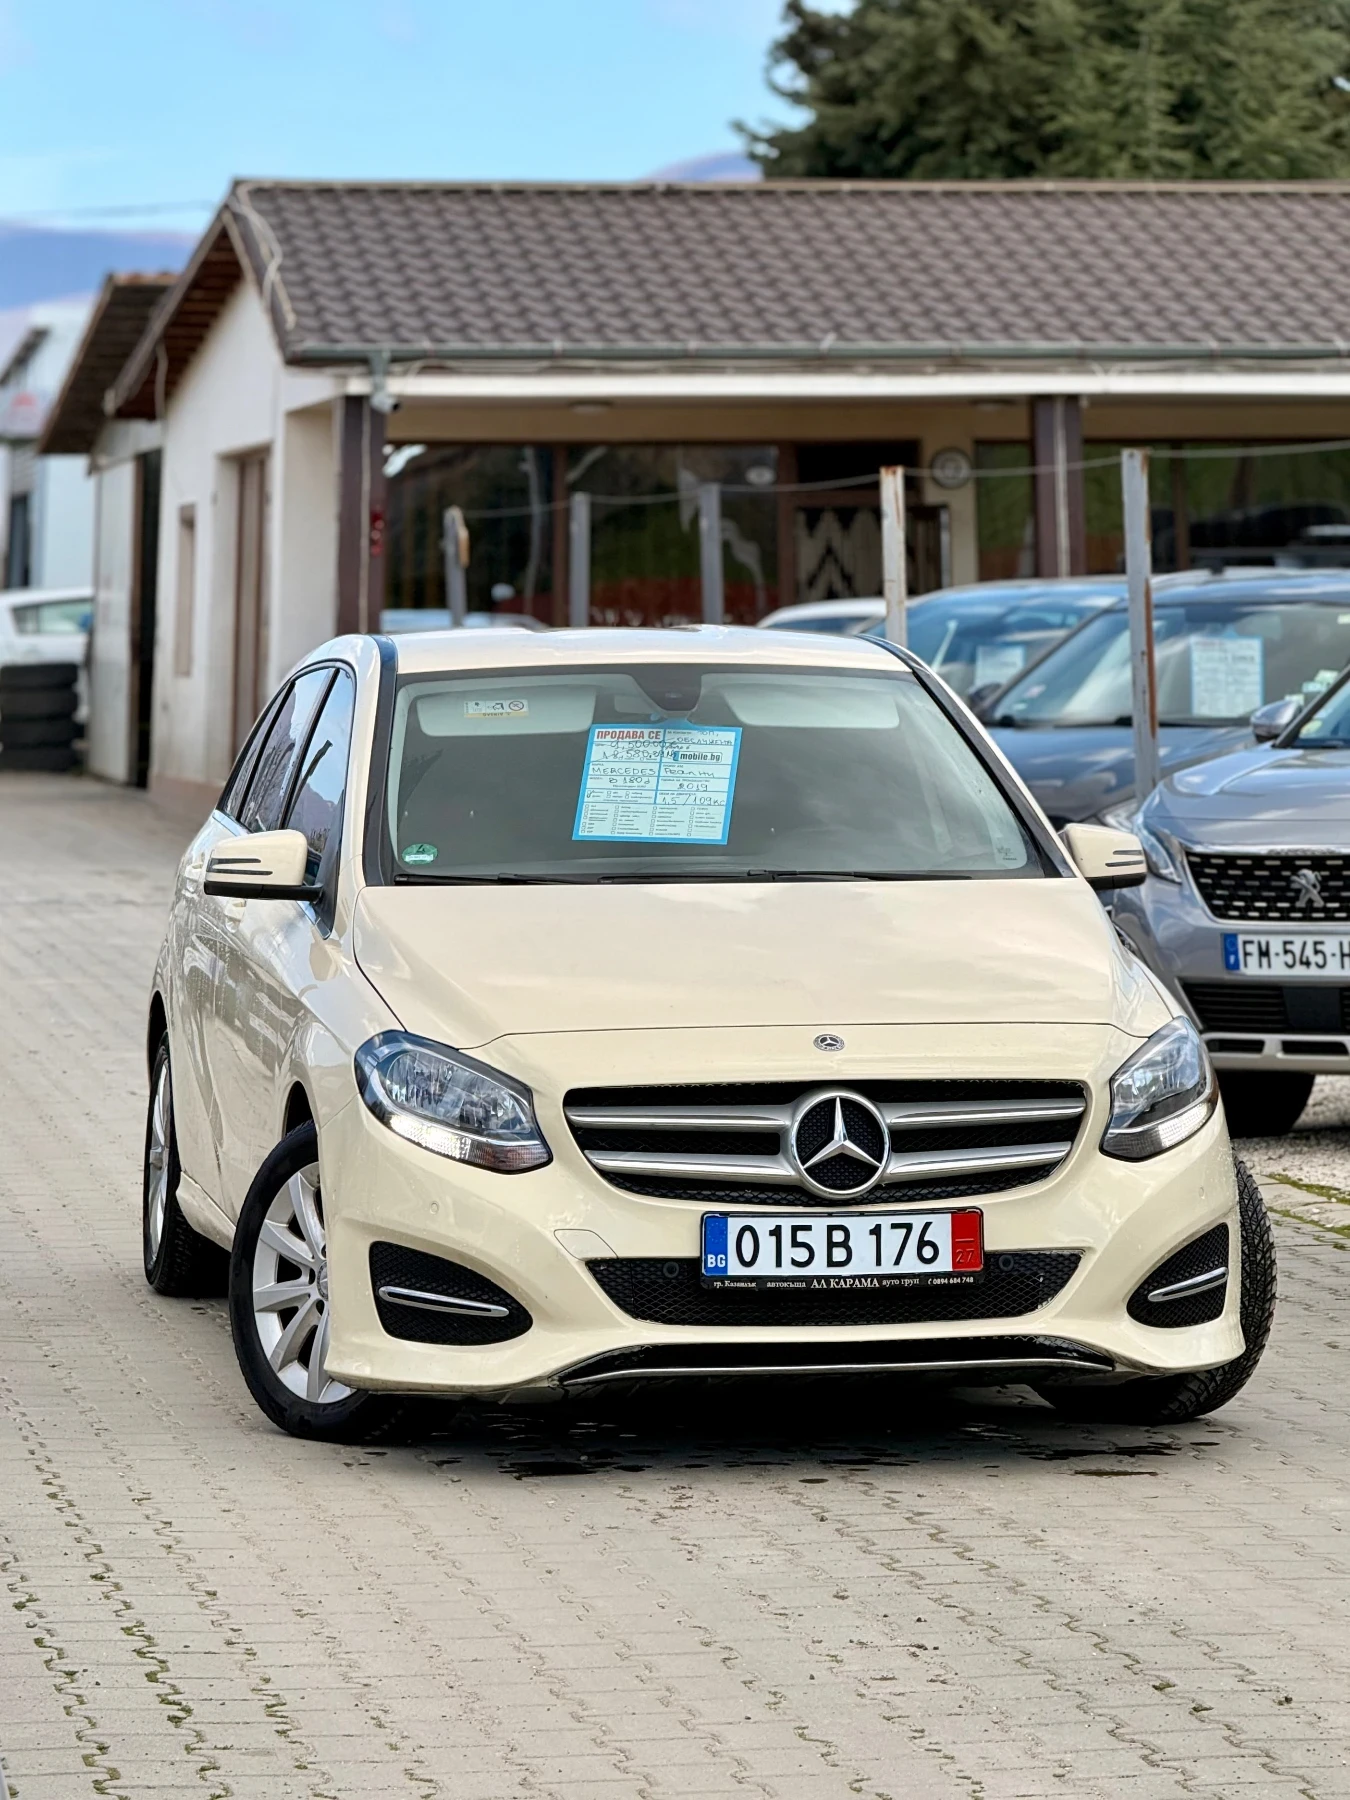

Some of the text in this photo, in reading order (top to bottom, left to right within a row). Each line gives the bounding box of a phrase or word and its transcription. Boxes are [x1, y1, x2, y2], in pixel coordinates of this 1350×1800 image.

[596, 730, 645, 740] ПРОДАВА
[647, 730, 662, 740] СЕ
[680, 753, 721, 761] mobile.bg
[592, 767, 656, 776] MERCEDES
[677, 782, 708, 791] 2019
[868, 1221, 940, 1267] 176
[955, 1248, 975, 1263] 27
[707, 1254, 726, 1268] BG
[810, 1278, 827, 1288] АЛ
[829, 1278, 880, 1288] КАРАМА
